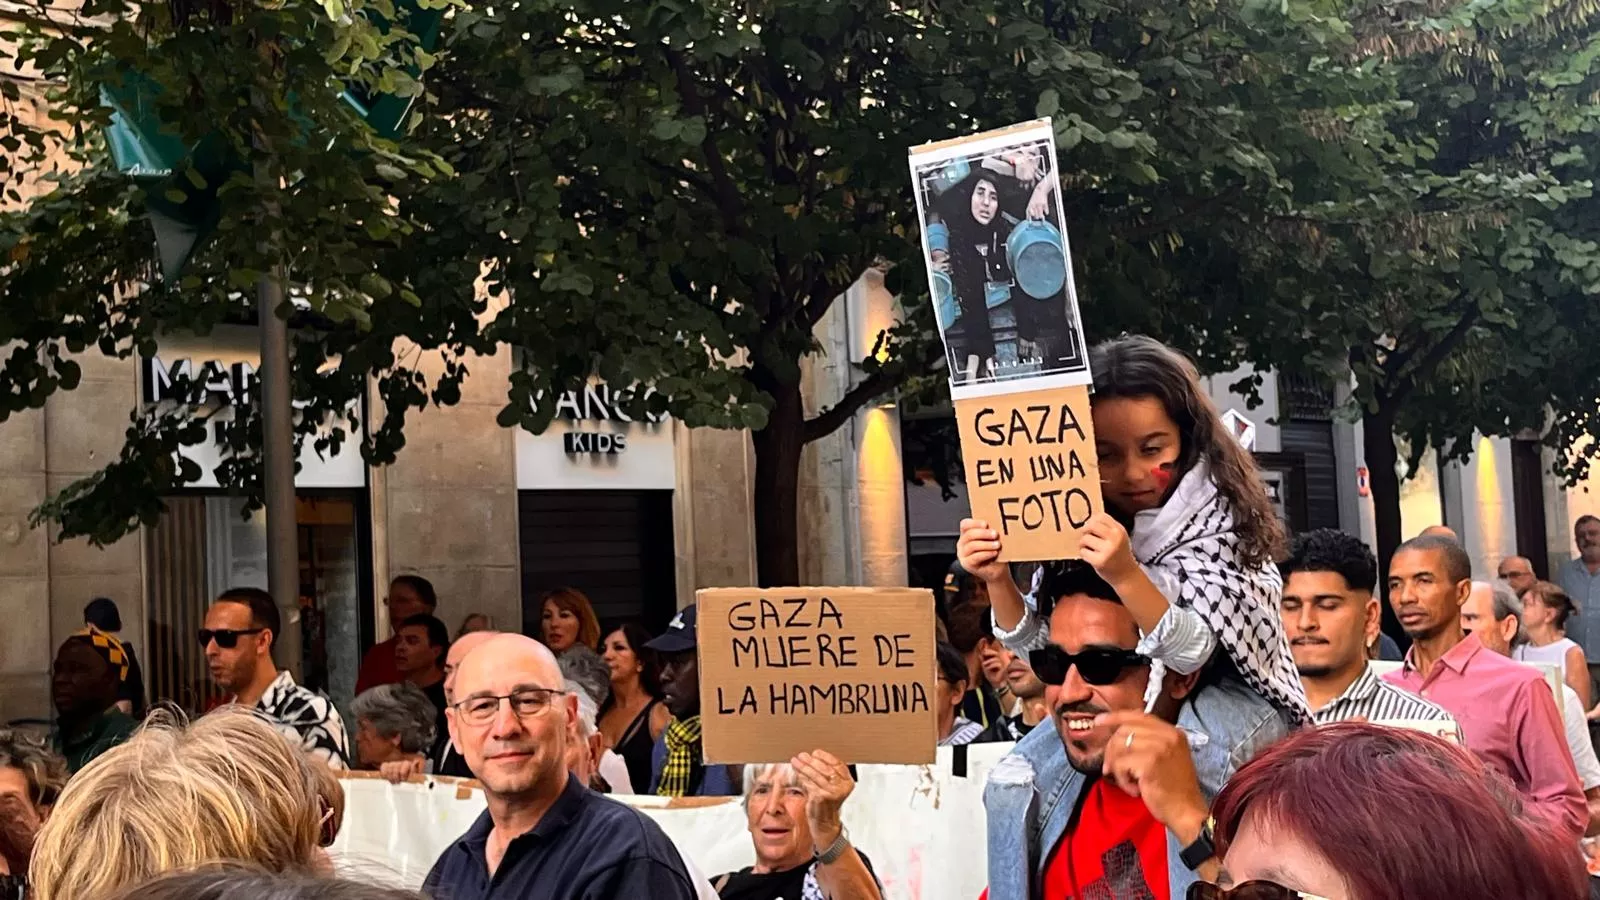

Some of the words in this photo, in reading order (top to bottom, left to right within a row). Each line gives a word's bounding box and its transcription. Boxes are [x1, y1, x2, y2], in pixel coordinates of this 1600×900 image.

[571, 433, 627, 452] KIDS
[974, 404, 1086, 447] GAZA
[976, 458, 1014, 487] EN
[1029, 449, 1086, 483] UNA
[998, 488, 1092, 535] FOTO
[728, 598, 843, 631] GAZA
[732, 634, 858, 668] MUERE
[873, 634, 915, 667] DE
[717, 686, 758, 715] LA
[769, 682, 929, 715] HAMBRUNA
